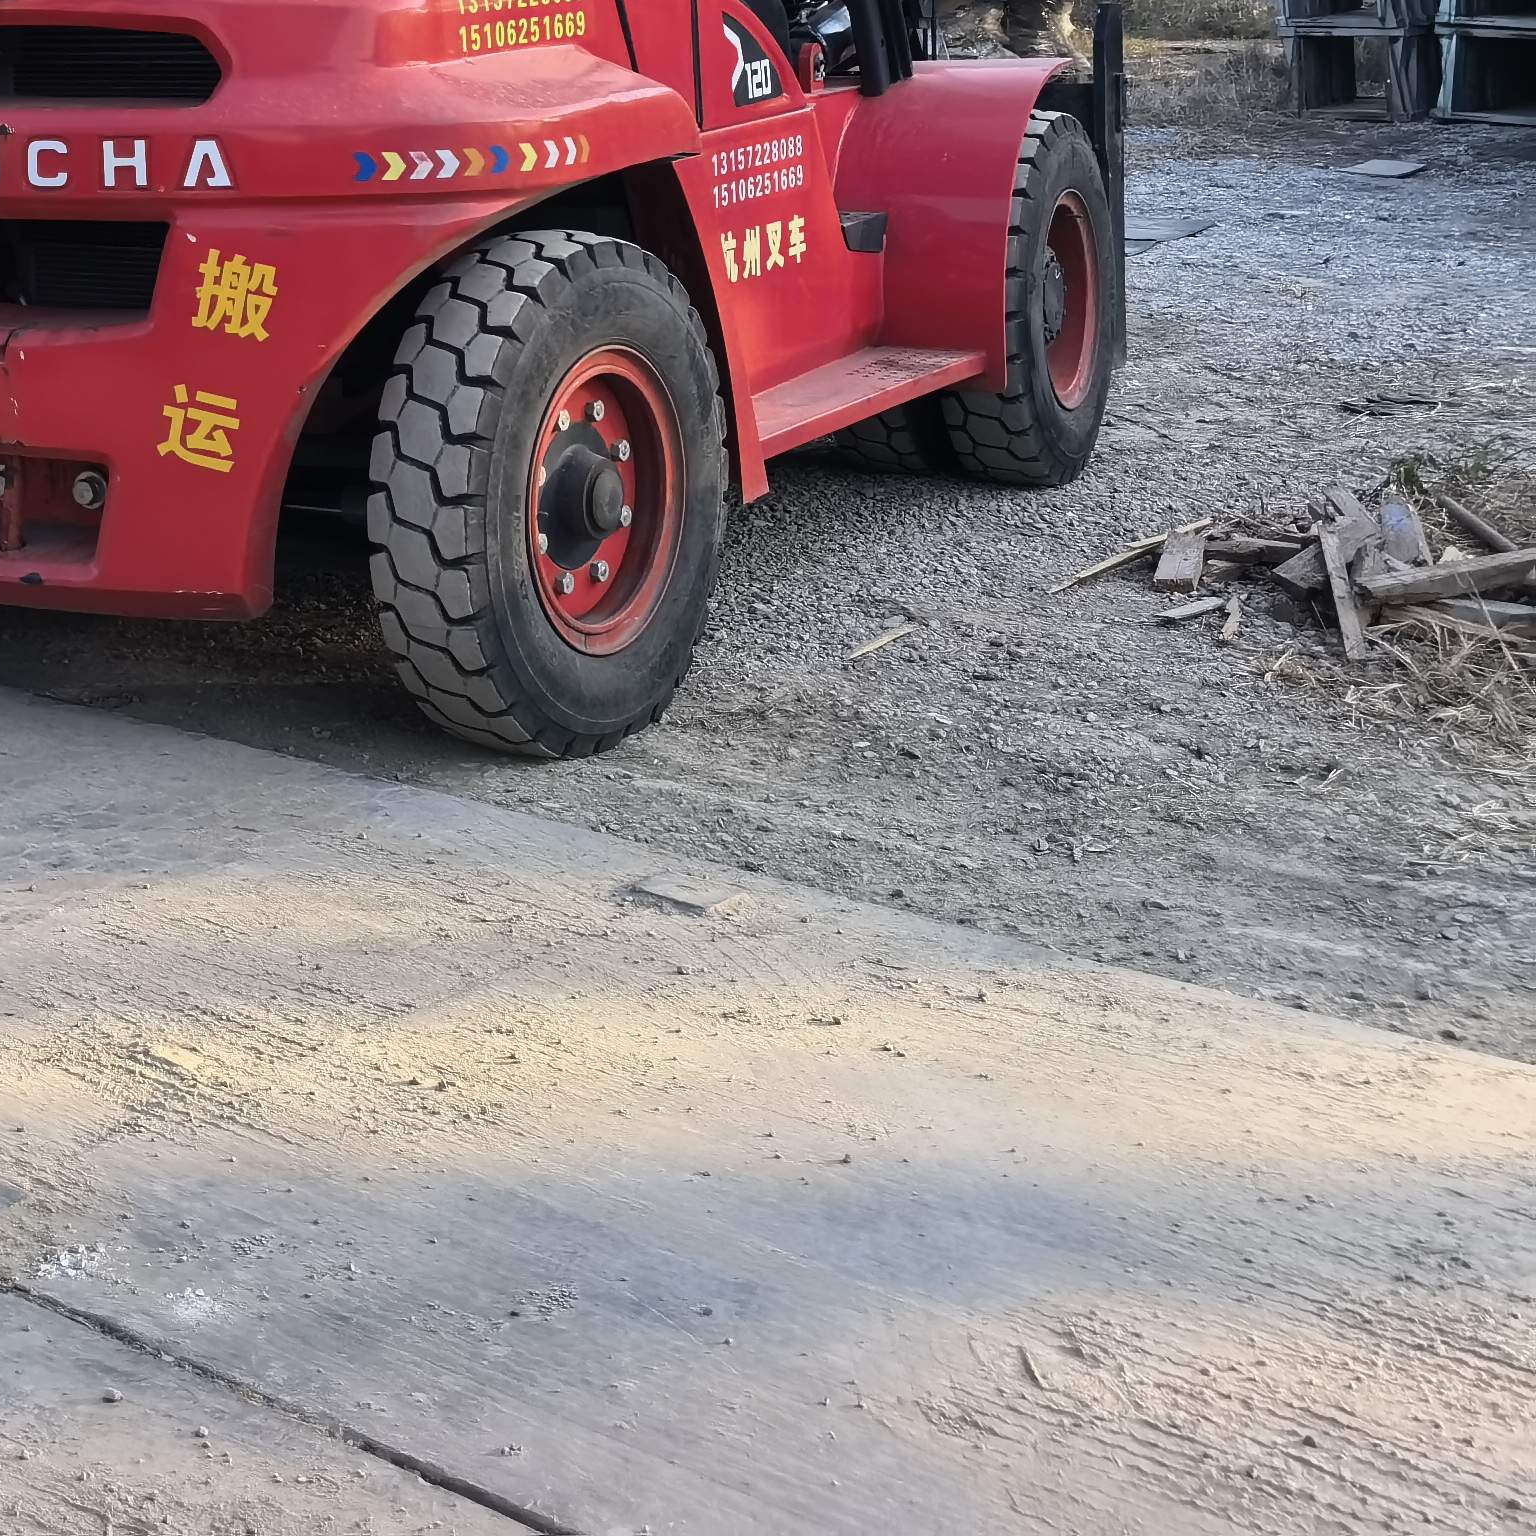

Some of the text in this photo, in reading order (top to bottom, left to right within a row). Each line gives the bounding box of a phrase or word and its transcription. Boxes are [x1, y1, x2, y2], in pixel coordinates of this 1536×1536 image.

[459, 10, 586, 52] 15106251669
[744, 58, 772, 99] 120
[712, 134, 803, 177] 13157228088
[713, 164, 804, 209] 15106251669
